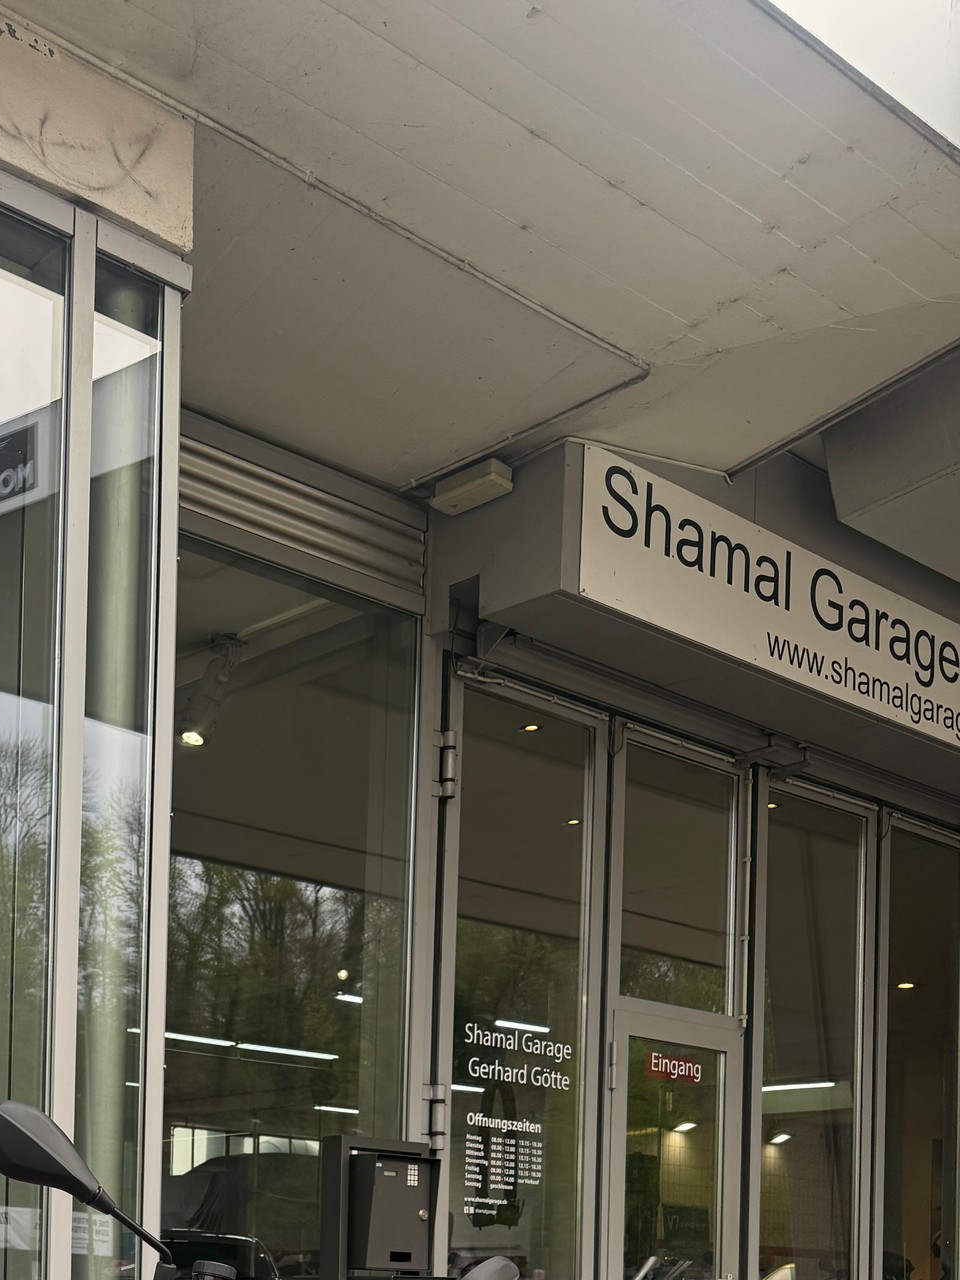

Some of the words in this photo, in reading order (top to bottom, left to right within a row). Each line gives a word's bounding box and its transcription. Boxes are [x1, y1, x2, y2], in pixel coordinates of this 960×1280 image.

[601, 465, 792, 611] Shamal
[810, 567, 960, 688] Garage
[464, 1023, 518, 1051] Shamal
[522, 1033, 572, 1063] Garage
[468, 1057, 527, 1084] Gerhard
[531, 1067, 570, 1090] Götte
[651, 1052, 701, 1083] Eingang
